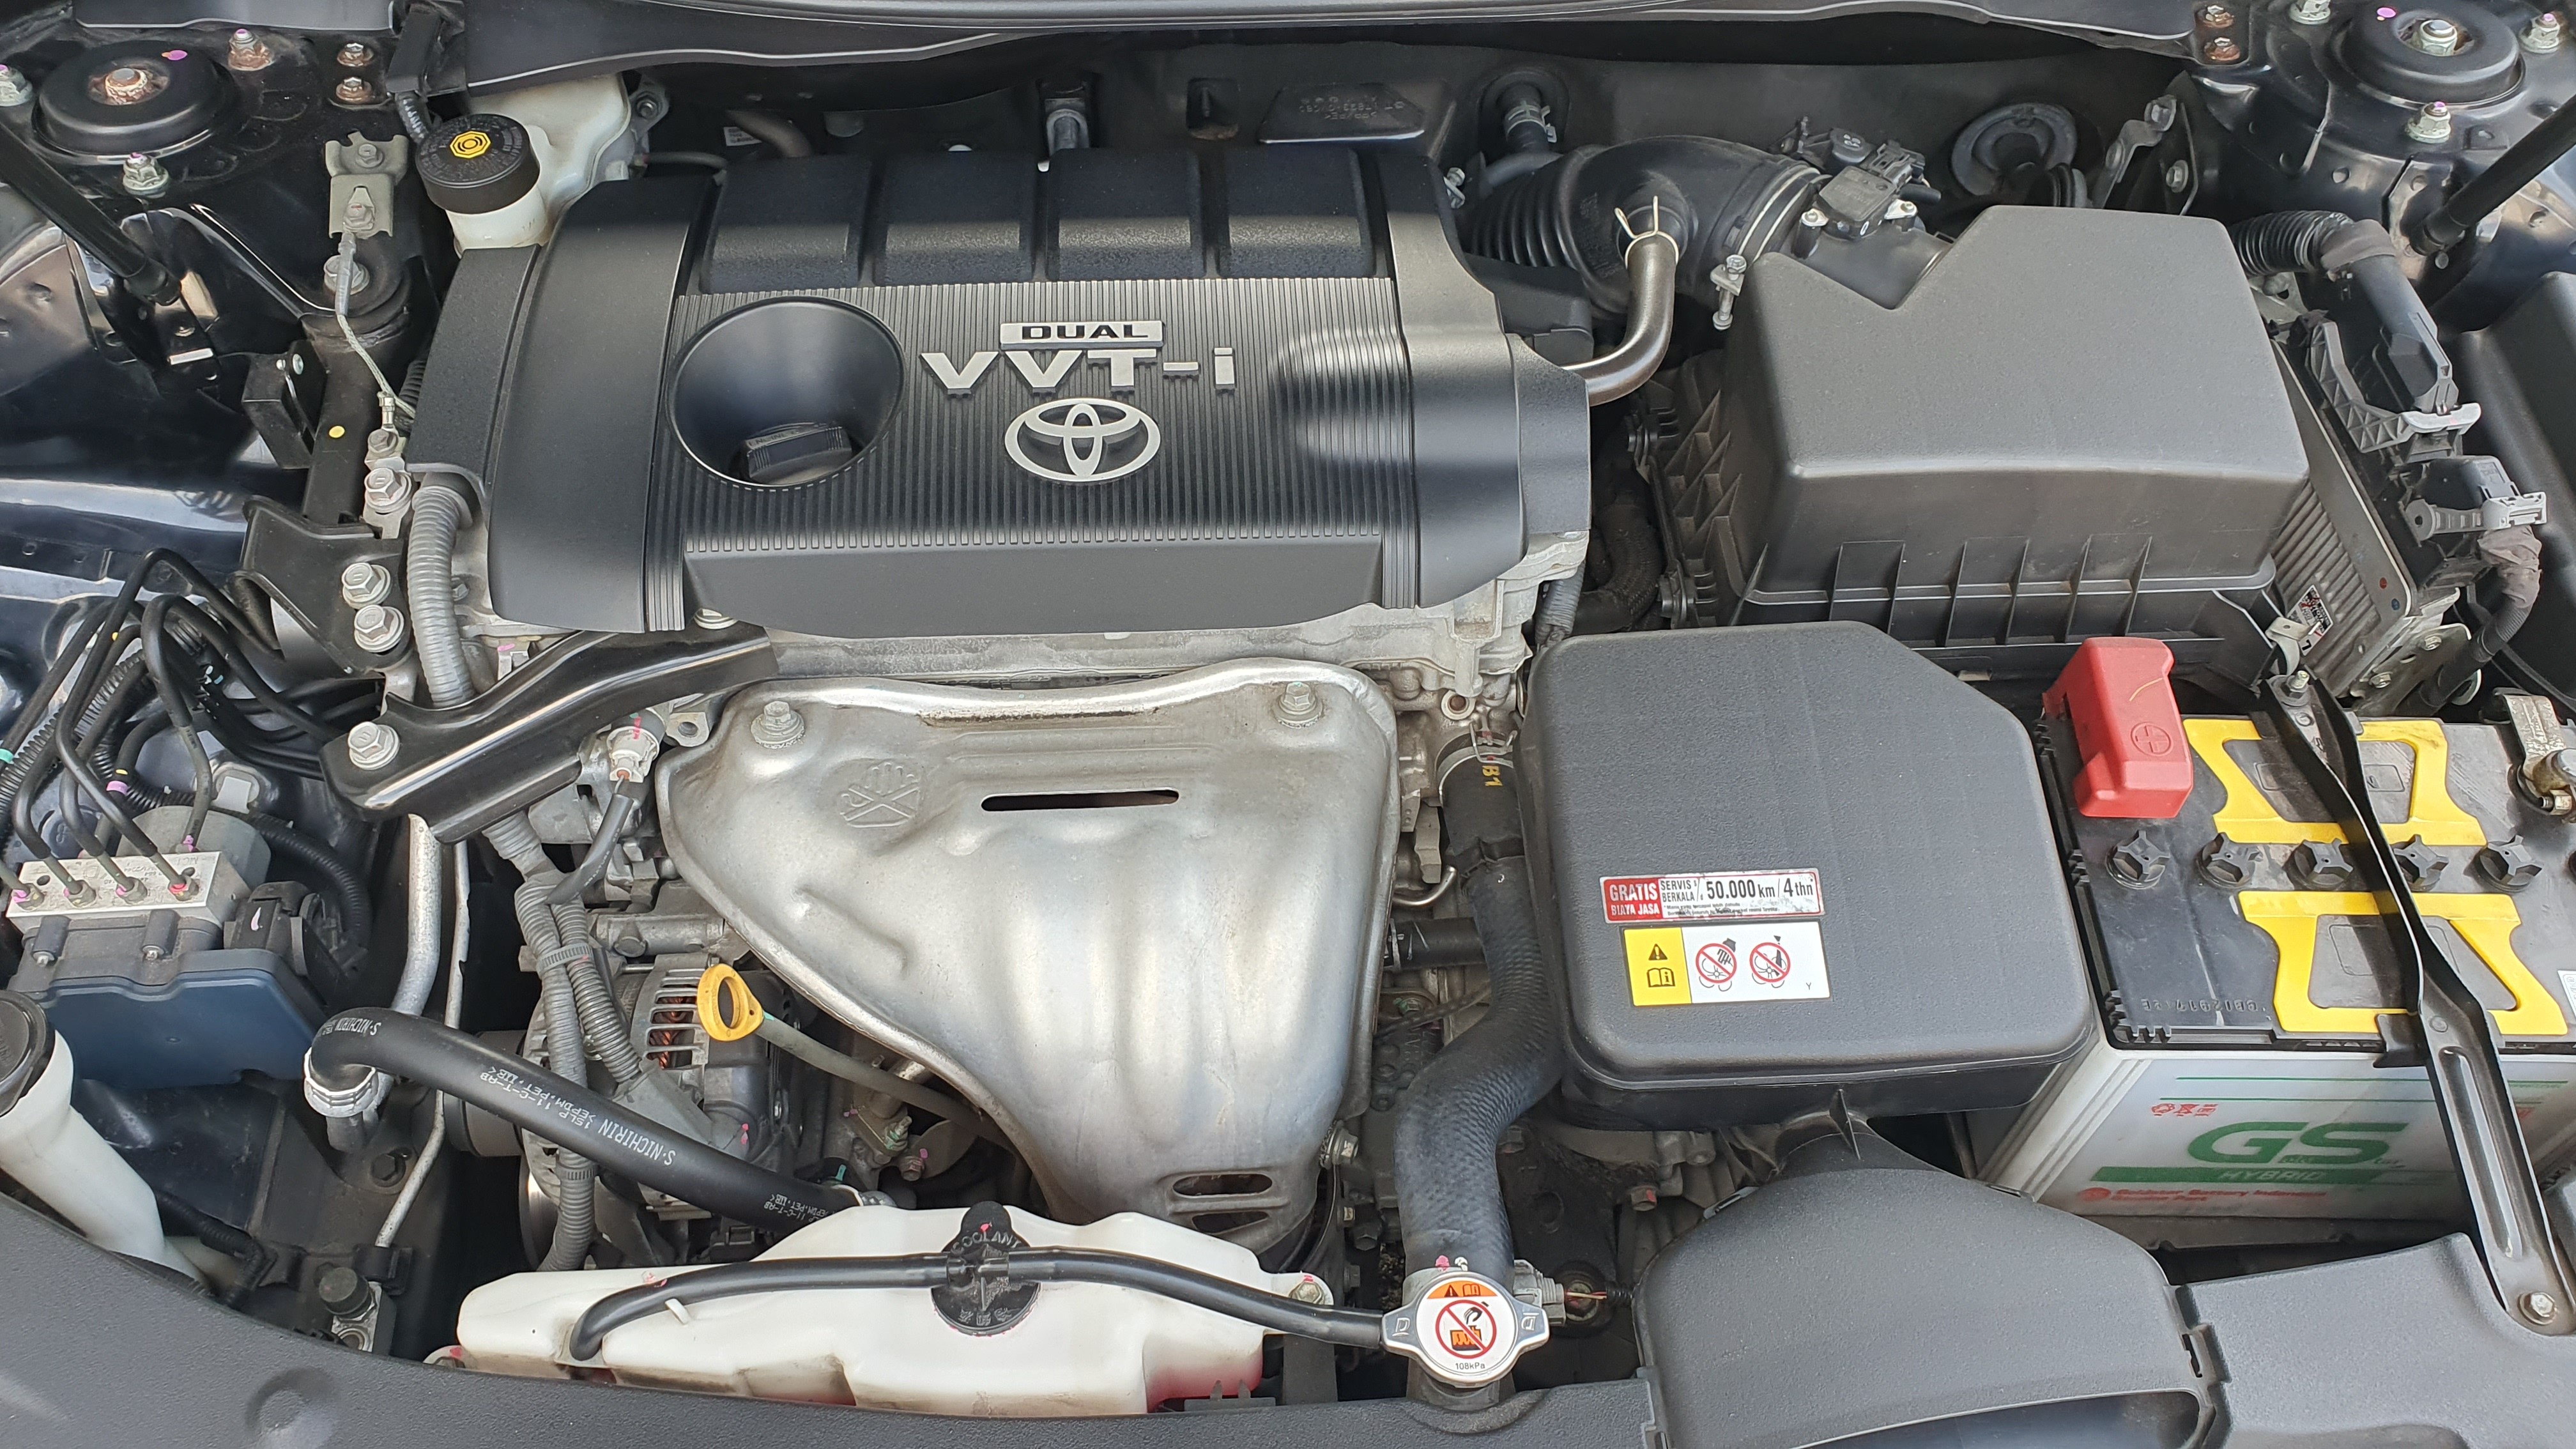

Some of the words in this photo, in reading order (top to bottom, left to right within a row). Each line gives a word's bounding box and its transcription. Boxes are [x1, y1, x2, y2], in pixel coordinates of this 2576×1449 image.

[1022, 324, 1149, 339] DUAL
[920, 347, 1236, 392] VVT-i
[1609, 882, 1658, 901] GRATIS
[1661, 879, 1692, 891] SERVIS
[1706, 879, 1756, 900] 50.000
[1662, 891, 1694, 903] BERKALA
[1611, 904, 1636, 916] BIAYA
[1637, 903, 1660, 916] JASA
[1805, 982, 1812, 991] Y
[2187, 1121, 2409, 1163] GS
[951, 1230, 1022, 1255] COOLANT
[1455, 1362, 1485, 1370] 108kPa
